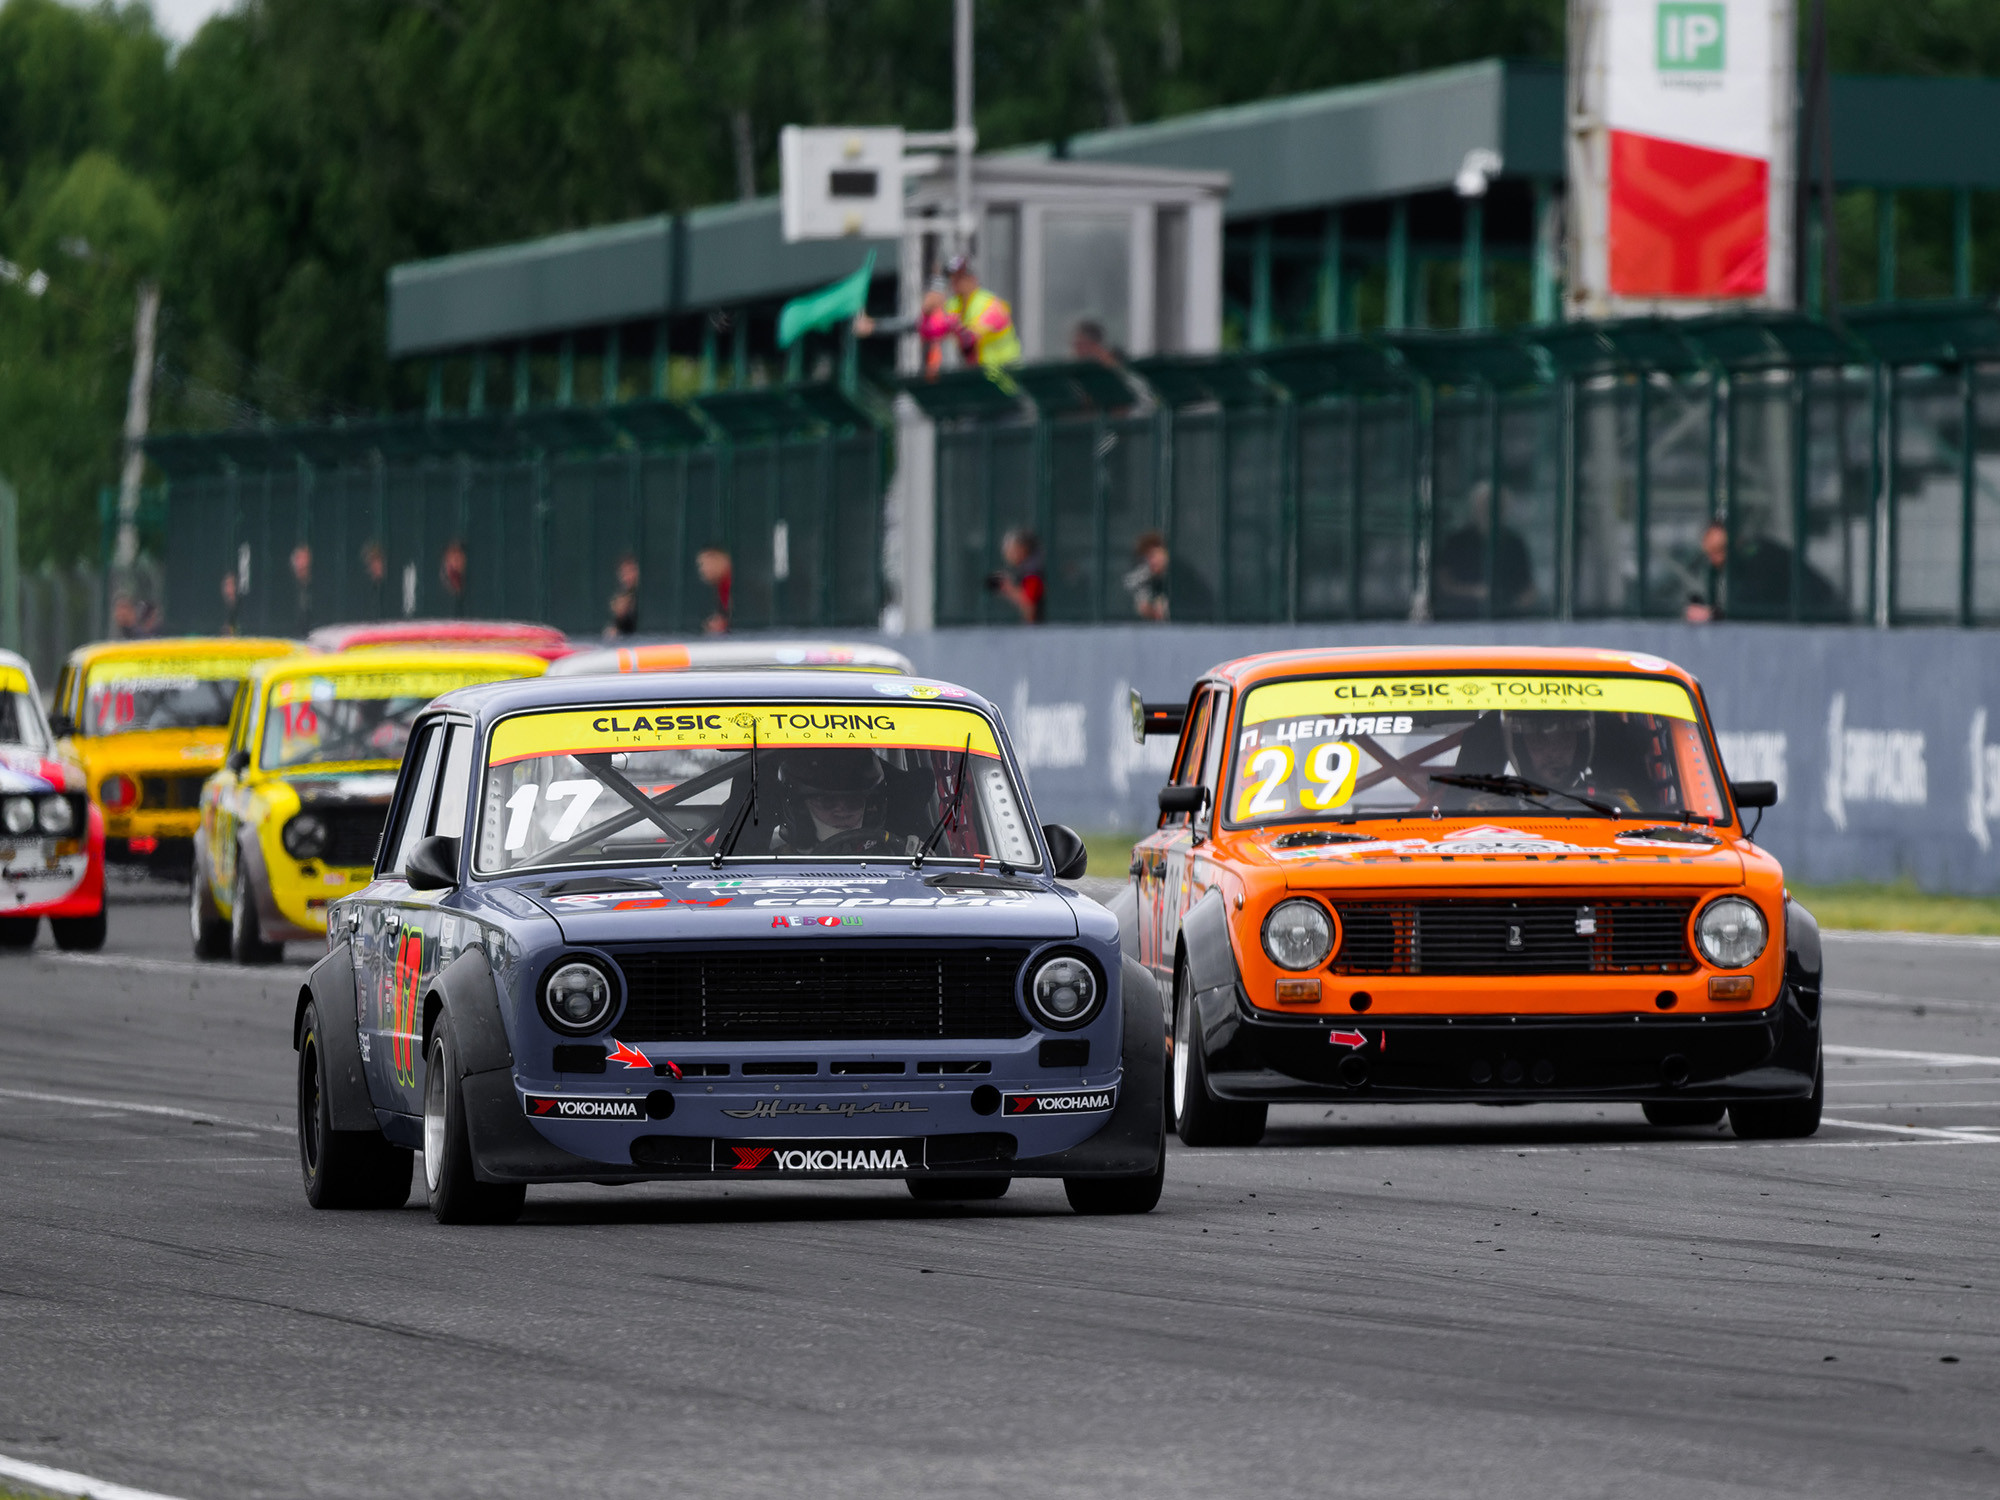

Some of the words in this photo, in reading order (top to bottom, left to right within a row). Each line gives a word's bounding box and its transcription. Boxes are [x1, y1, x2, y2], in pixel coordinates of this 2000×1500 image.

[1666, 14, 1719, 61] IP
[1334, 683, 1450, 698] CLASSIC
[1491, 682, 1604, 697] TOURING
[1352, 698, 1588, 707] INTERNATIONAL
[592, 714, 721, 732] CLASSIC
[769, 713, 896, 731] TOURING
[616, 732, 878, 742] INTERNATIONAL
[1240, 729, 1266, 751] П.
[1276, 716, 1414, 743] ЦЕПЛЯЕВ
[1236, 741, 1361, 822] 29
[504, 779, 604, 851] 17
[557, 1101, 638, 1116] YOKOHAMA
[1036, 1094, 1110, 1111] YOKOHAMA
[773, 1149, 909, 1170] YOKOHAMA
